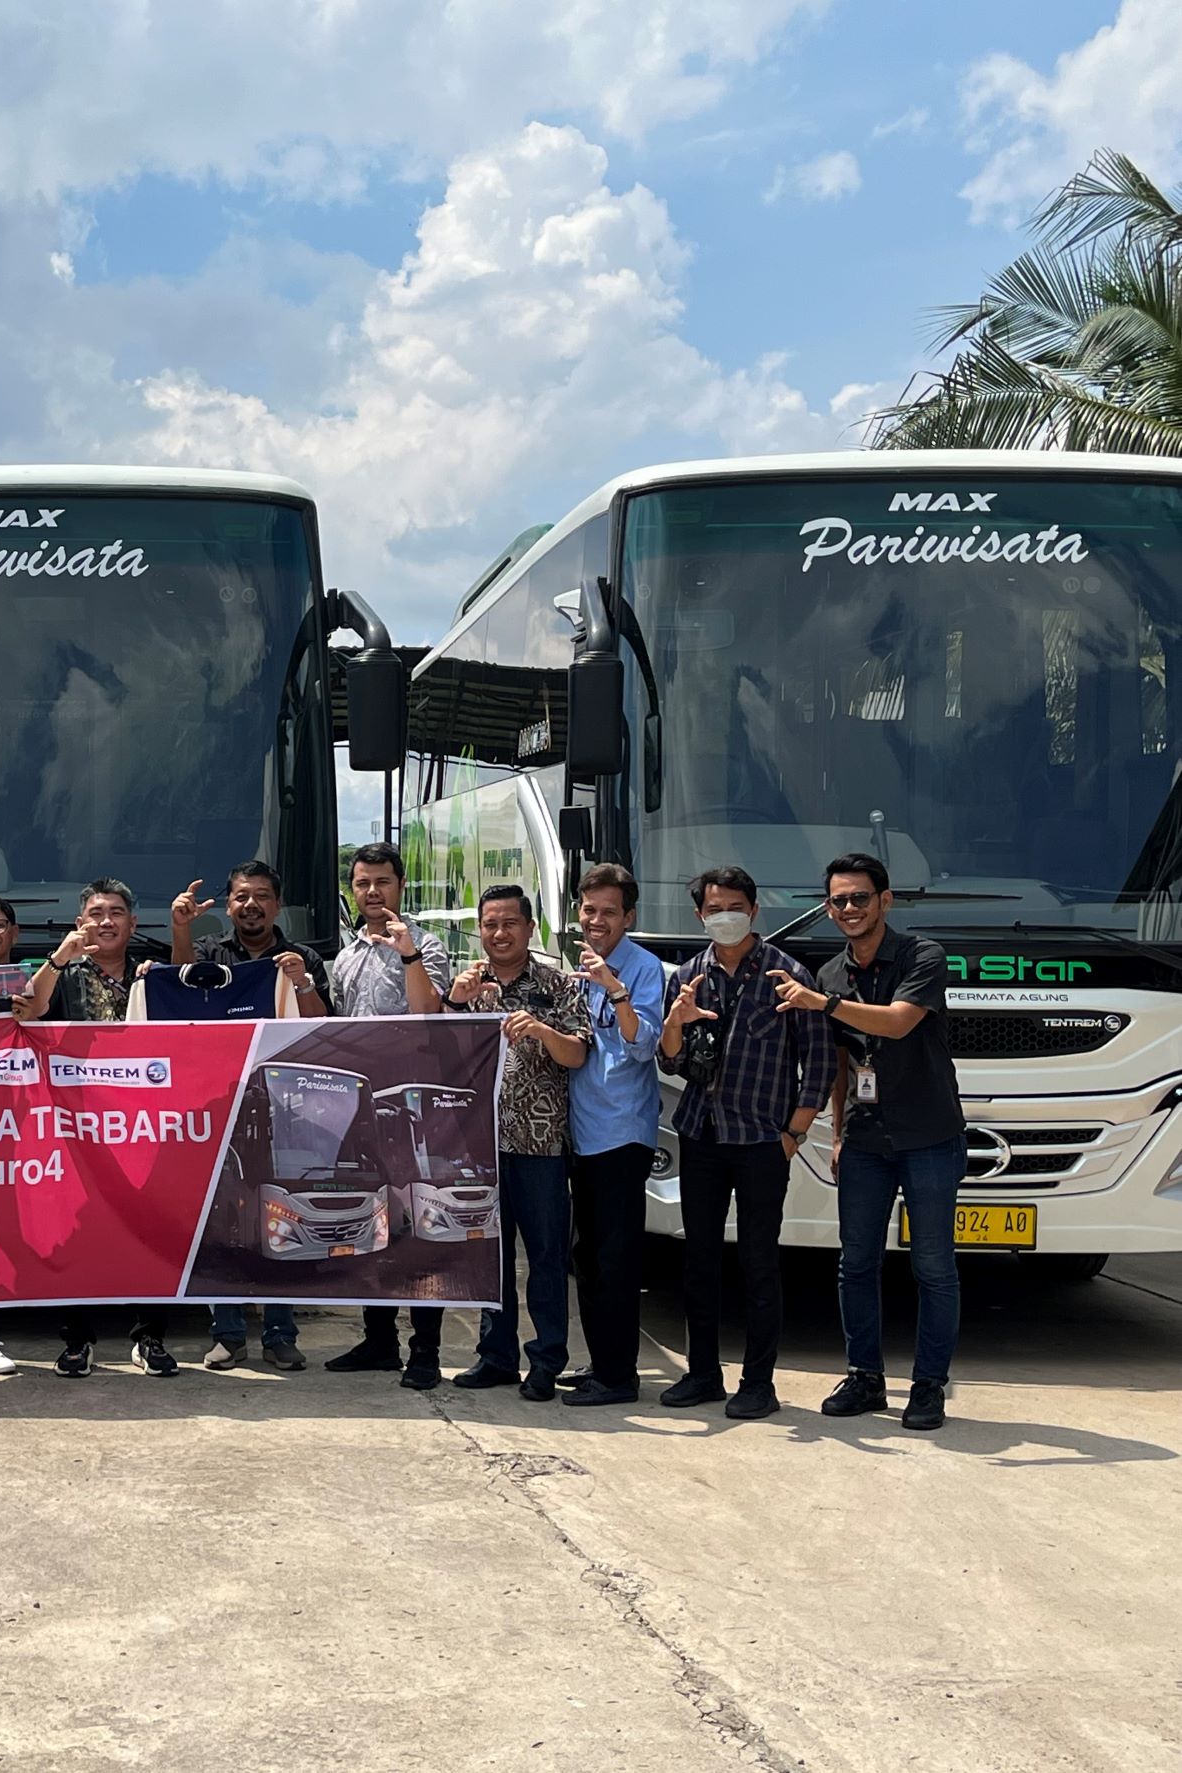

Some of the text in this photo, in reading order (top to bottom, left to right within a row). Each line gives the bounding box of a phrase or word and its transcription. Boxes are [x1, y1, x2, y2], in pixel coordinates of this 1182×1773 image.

[888, 492, 998, 512] MAX
[799, 517, 1089, 573] Pariwisata
[979, 956, 1092, 981] Star
[948, 992, 1069, 1003] PERMATA AGUNG
[1042, 1017, 1102, 1028] TENTREM
[51, 1064, 140, 1079] TENTREM
[296, 1077, 348, 1093] Pariwisata
[30, 1106, 212, 1144] TERBARU
[956, 1210, 989, 1232] 924
